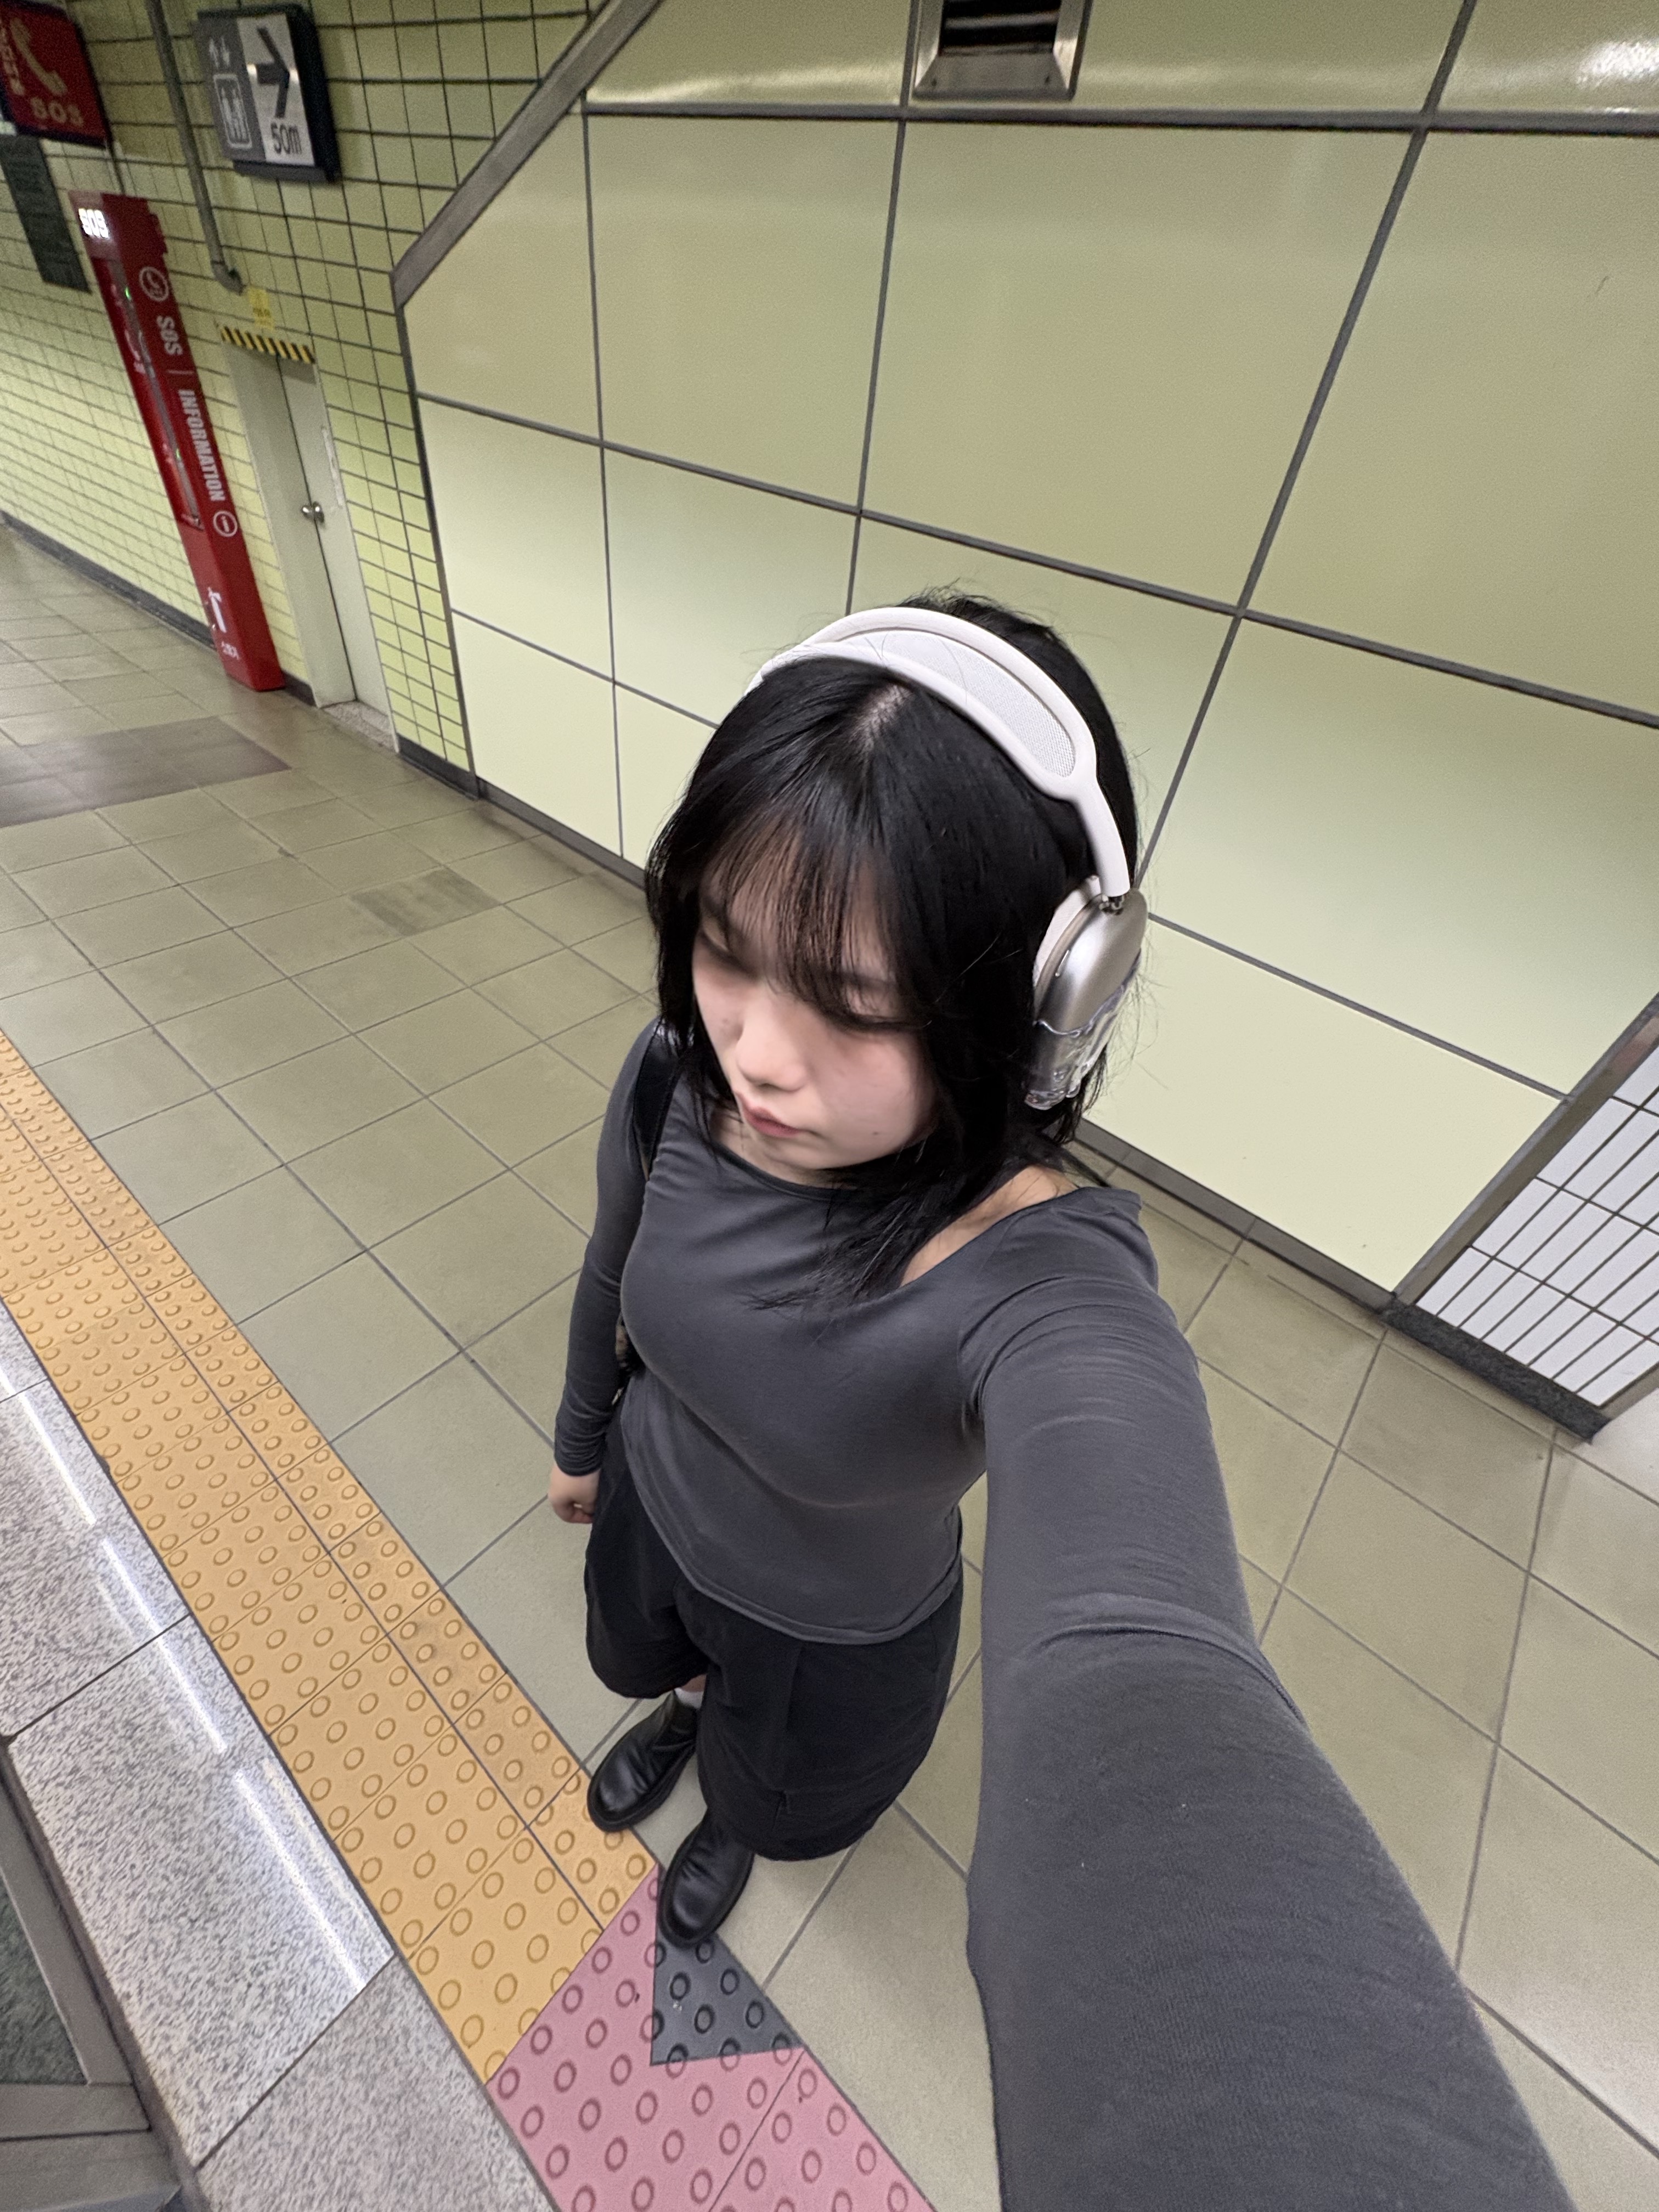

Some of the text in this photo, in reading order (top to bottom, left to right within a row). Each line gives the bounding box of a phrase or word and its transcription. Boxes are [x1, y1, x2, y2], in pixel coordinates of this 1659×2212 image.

[30, 97, 83, 127] SOS
[270, 122, 302, 154] 50m
[156, 315, 225, 501] SOS INFORMATION
